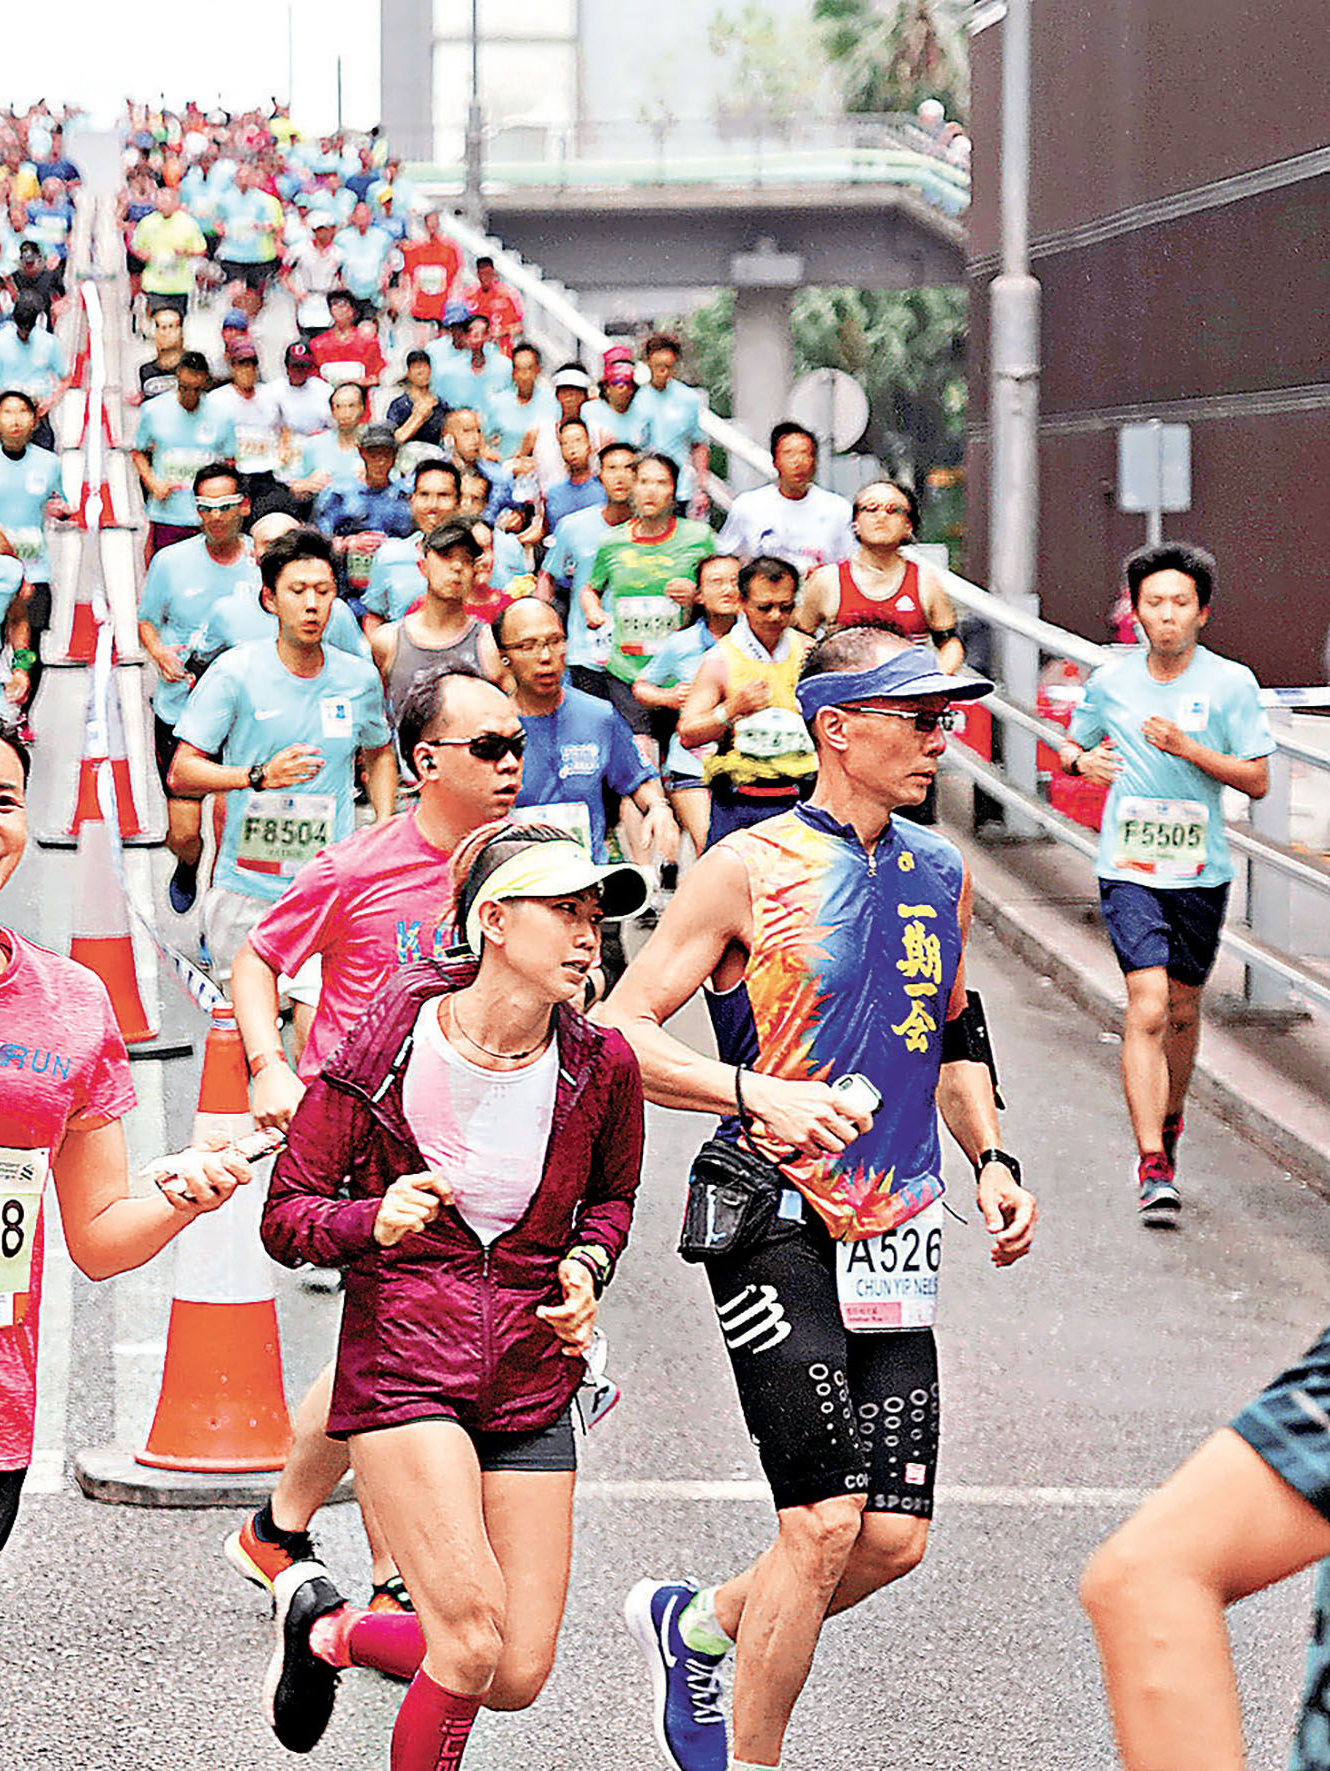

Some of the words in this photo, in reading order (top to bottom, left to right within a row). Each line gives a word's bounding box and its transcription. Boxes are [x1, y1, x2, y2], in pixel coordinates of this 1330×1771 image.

[244, 817, 327, 846] F8504
[1123, 820, 1202, 849] F5505
[6, 1044, 71, 1079] RUN
[856, 1278, 892, 1297] CHUN
